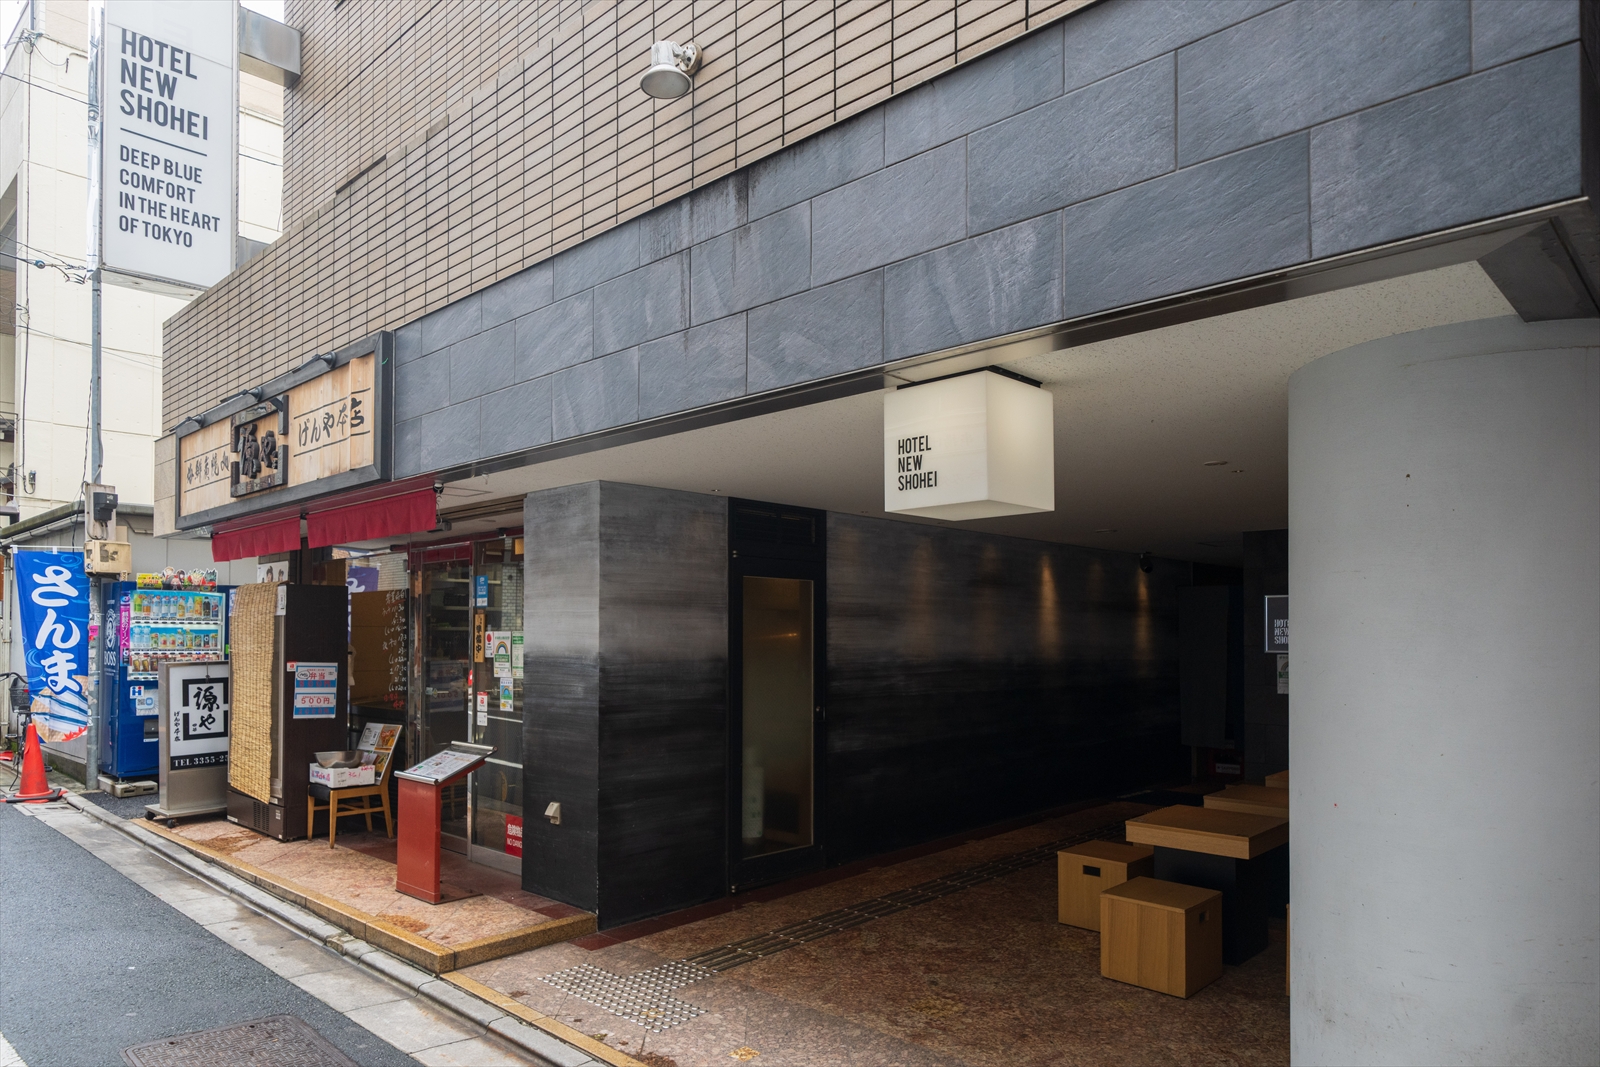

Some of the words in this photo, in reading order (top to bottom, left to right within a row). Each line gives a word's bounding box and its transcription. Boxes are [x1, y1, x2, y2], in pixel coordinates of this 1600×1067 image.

[121, 28, 197, 80] HOTEL
[121, 58, 177, 101] NEW
[120, 89, 208, 140] SHOHEI
[120, 144, 160, 171] DEEP
[163, 158, 202, 184] BLUE
[120, 168, 195, 204] COMFORT
[119, 191, 135, 211] IN
[138, 196, 167, 220] THE
[170, 205, 220, 232] HEART
[119, 215, 139, 234] OF
[142, 220, 192, 248] TOKYO
[298, 397, 365, 447] げんや本店
[897, 434, 932, 456] HOTEL
[897, 454, 923, 474] NEW
[897, 470, 938, 492] SHOHEI
[31, 565, 81, 693] さんま
[1274, 619, 1289, 628] HOT
[104, 650, 117, 667] BOSS
[193, 685, 220, 731] 源や
[173, 758, 192, 767] TEL
